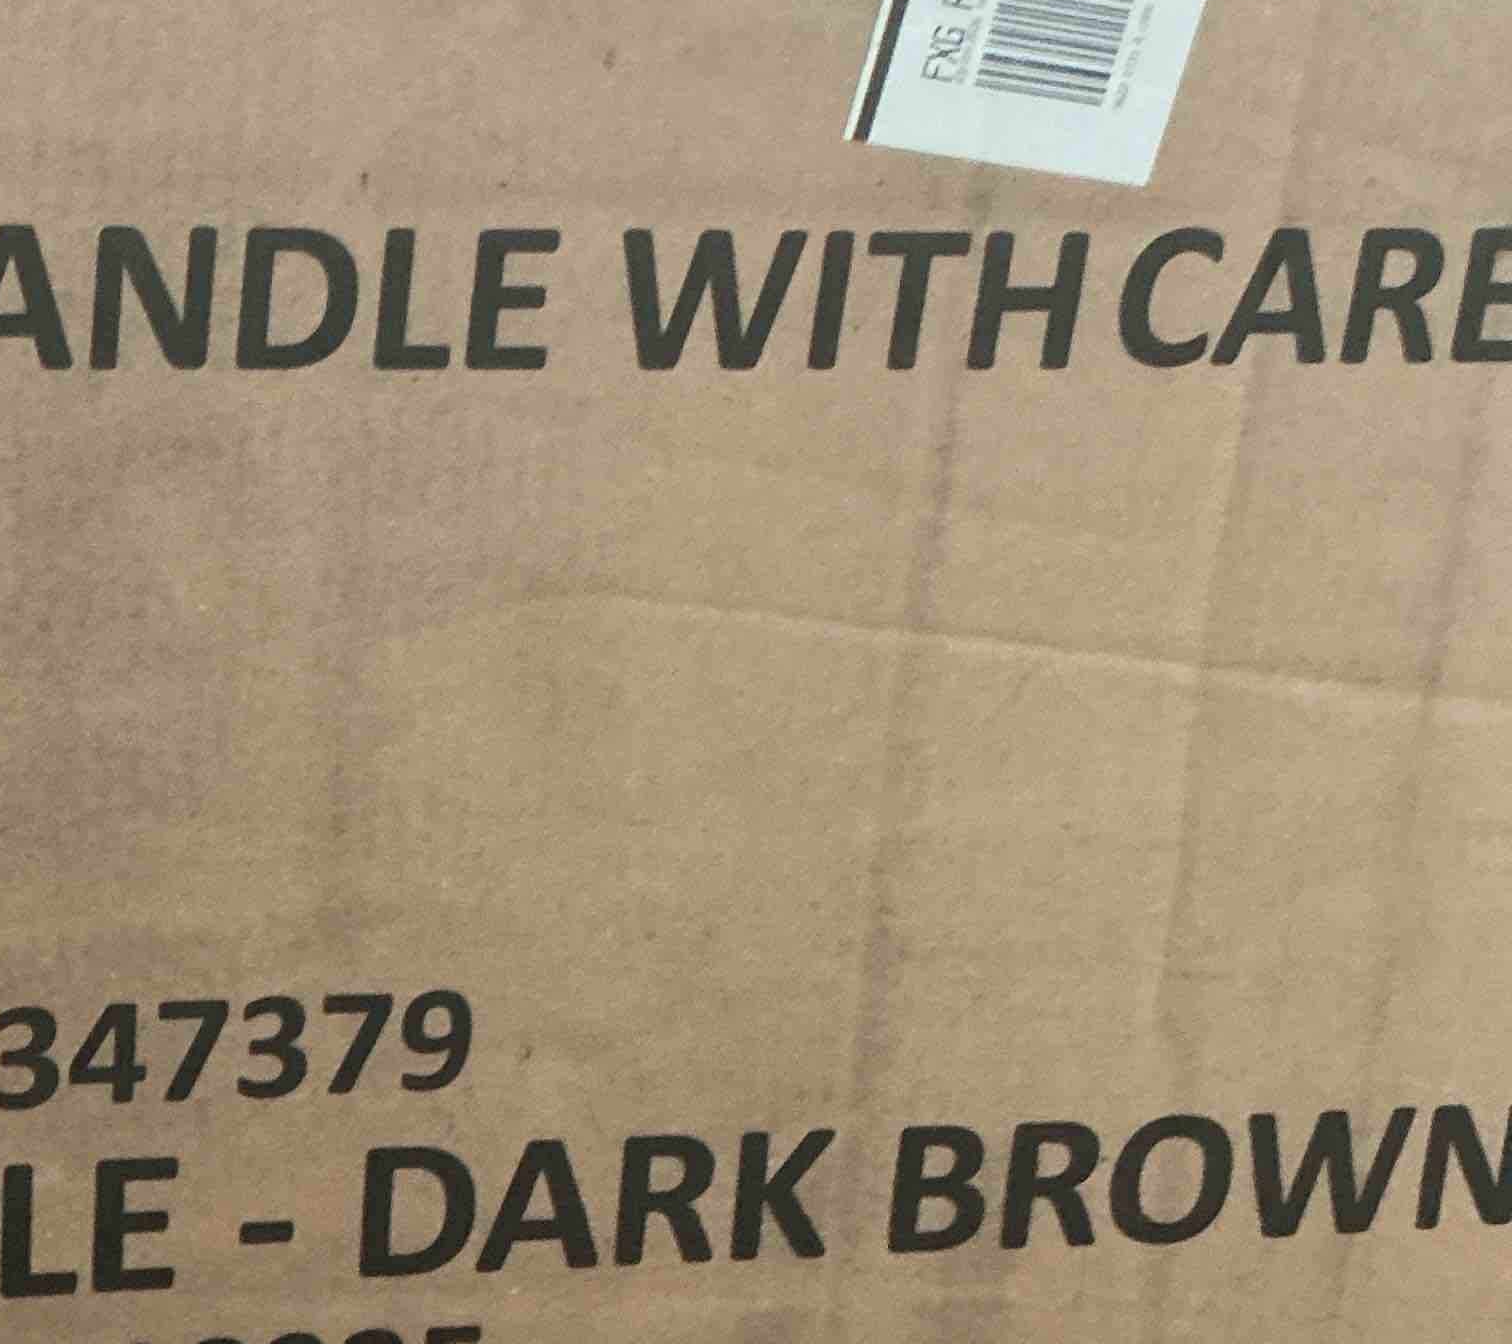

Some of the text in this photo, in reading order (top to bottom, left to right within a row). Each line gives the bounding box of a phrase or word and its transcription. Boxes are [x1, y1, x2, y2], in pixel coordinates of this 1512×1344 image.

[921, 25, 966, 84] FXG
[623, 229, 1090, 371] WITH
[1119, 227, 1512, 368] CARE
[238, 1220, 295, 1246] -
[359, 1129, 836, 1278] DARK
[888, 1105, 1512, 1254] BROWN
